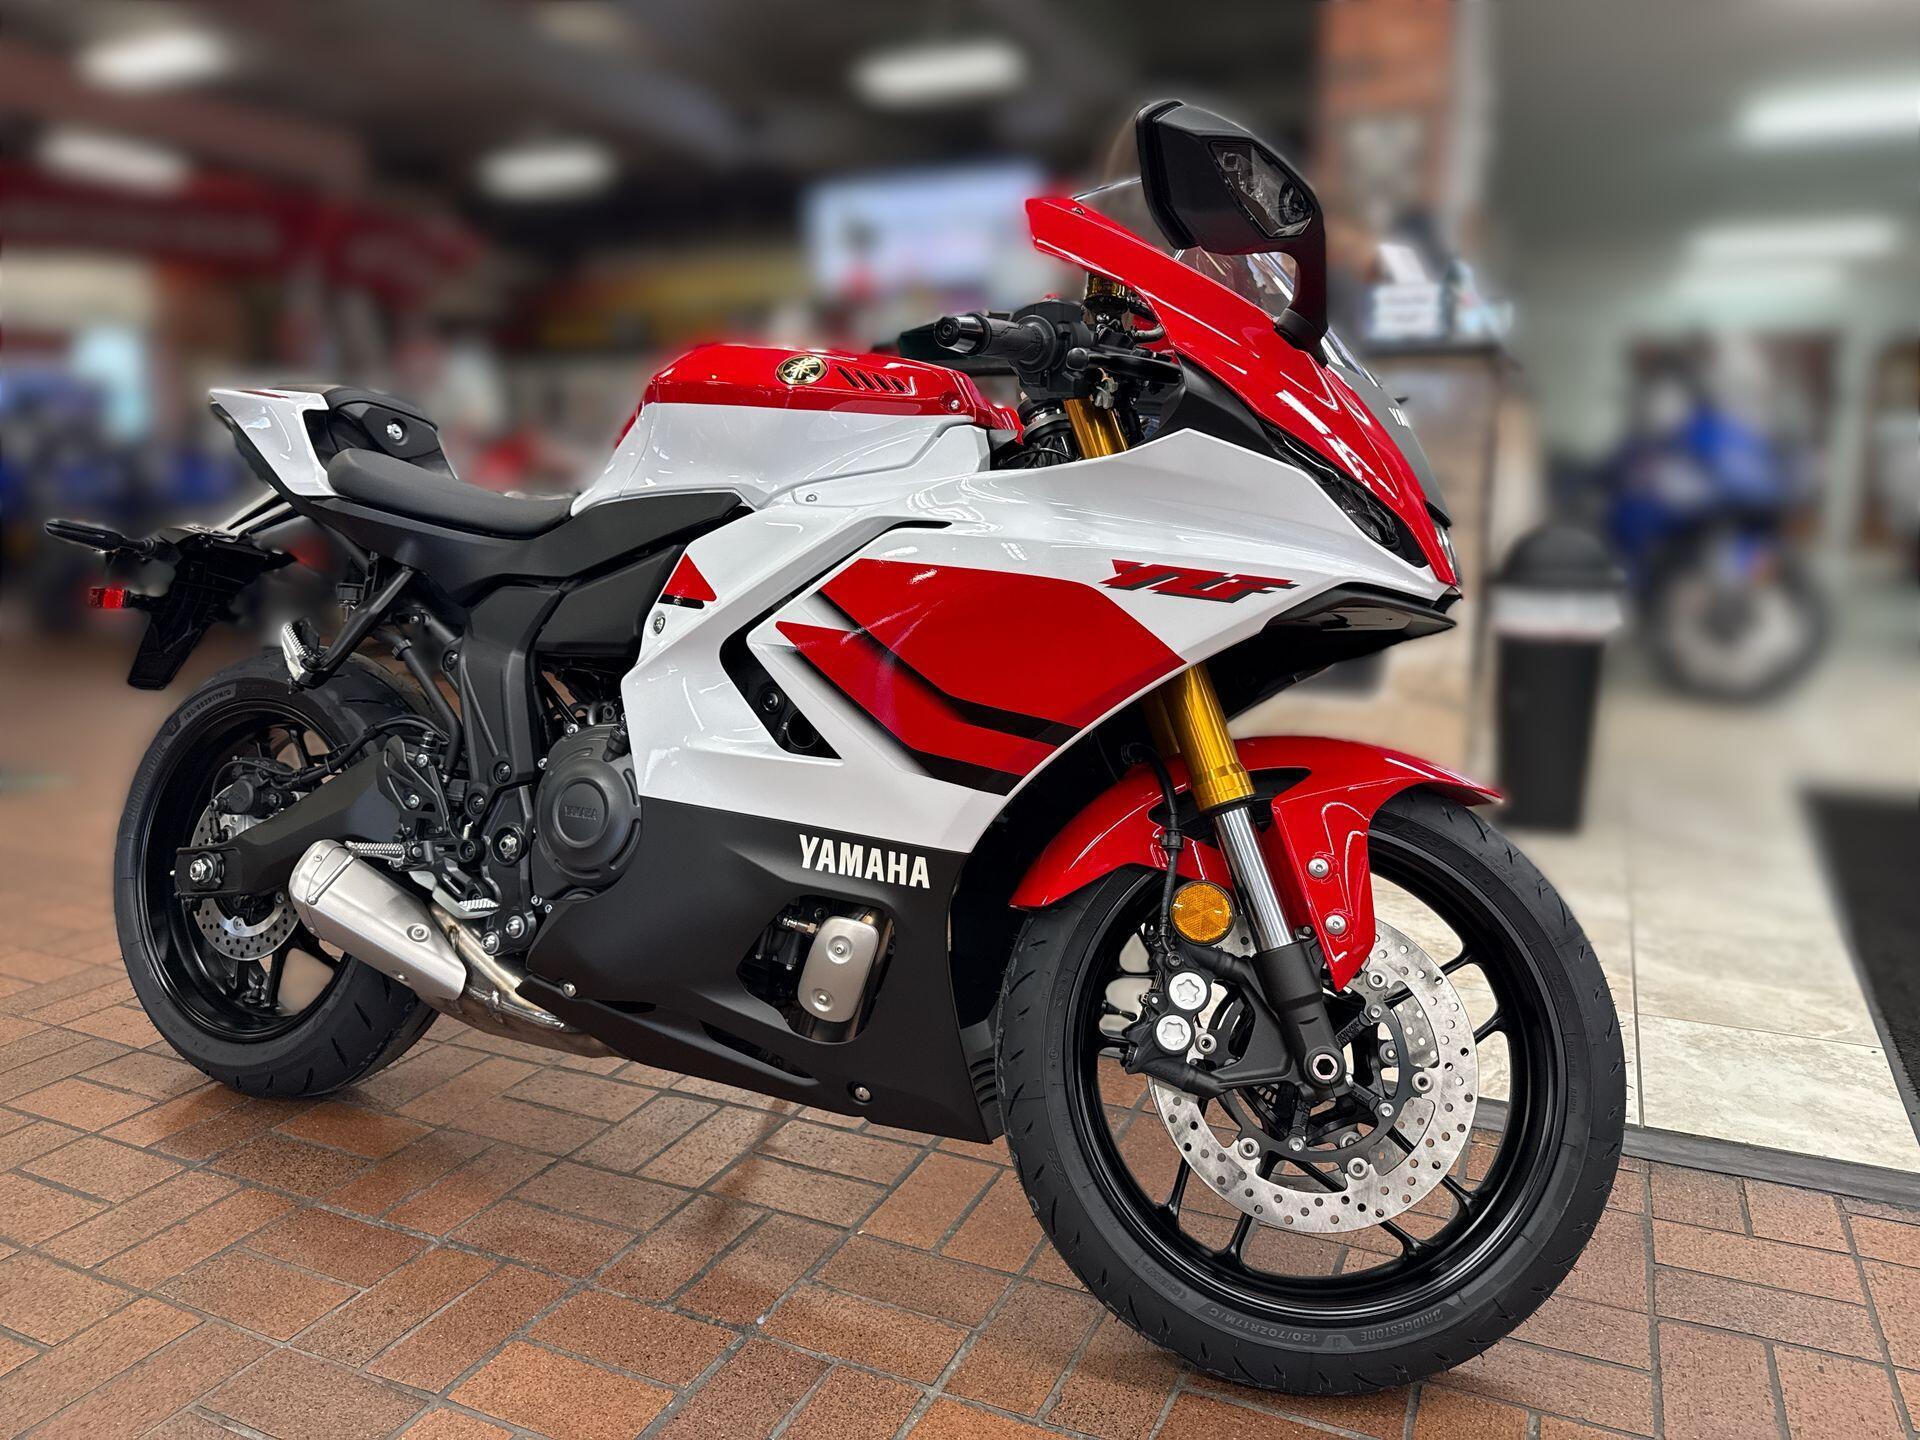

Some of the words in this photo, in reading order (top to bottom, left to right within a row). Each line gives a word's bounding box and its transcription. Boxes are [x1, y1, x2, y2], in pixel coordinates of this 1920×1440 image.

[799, 834, 931, 889] YAMAHA
[1208, 1307, 1318, 1343] 120/70ZR17M/C
[1360, 1308, 1444, 1342] BRIDGESTONE
